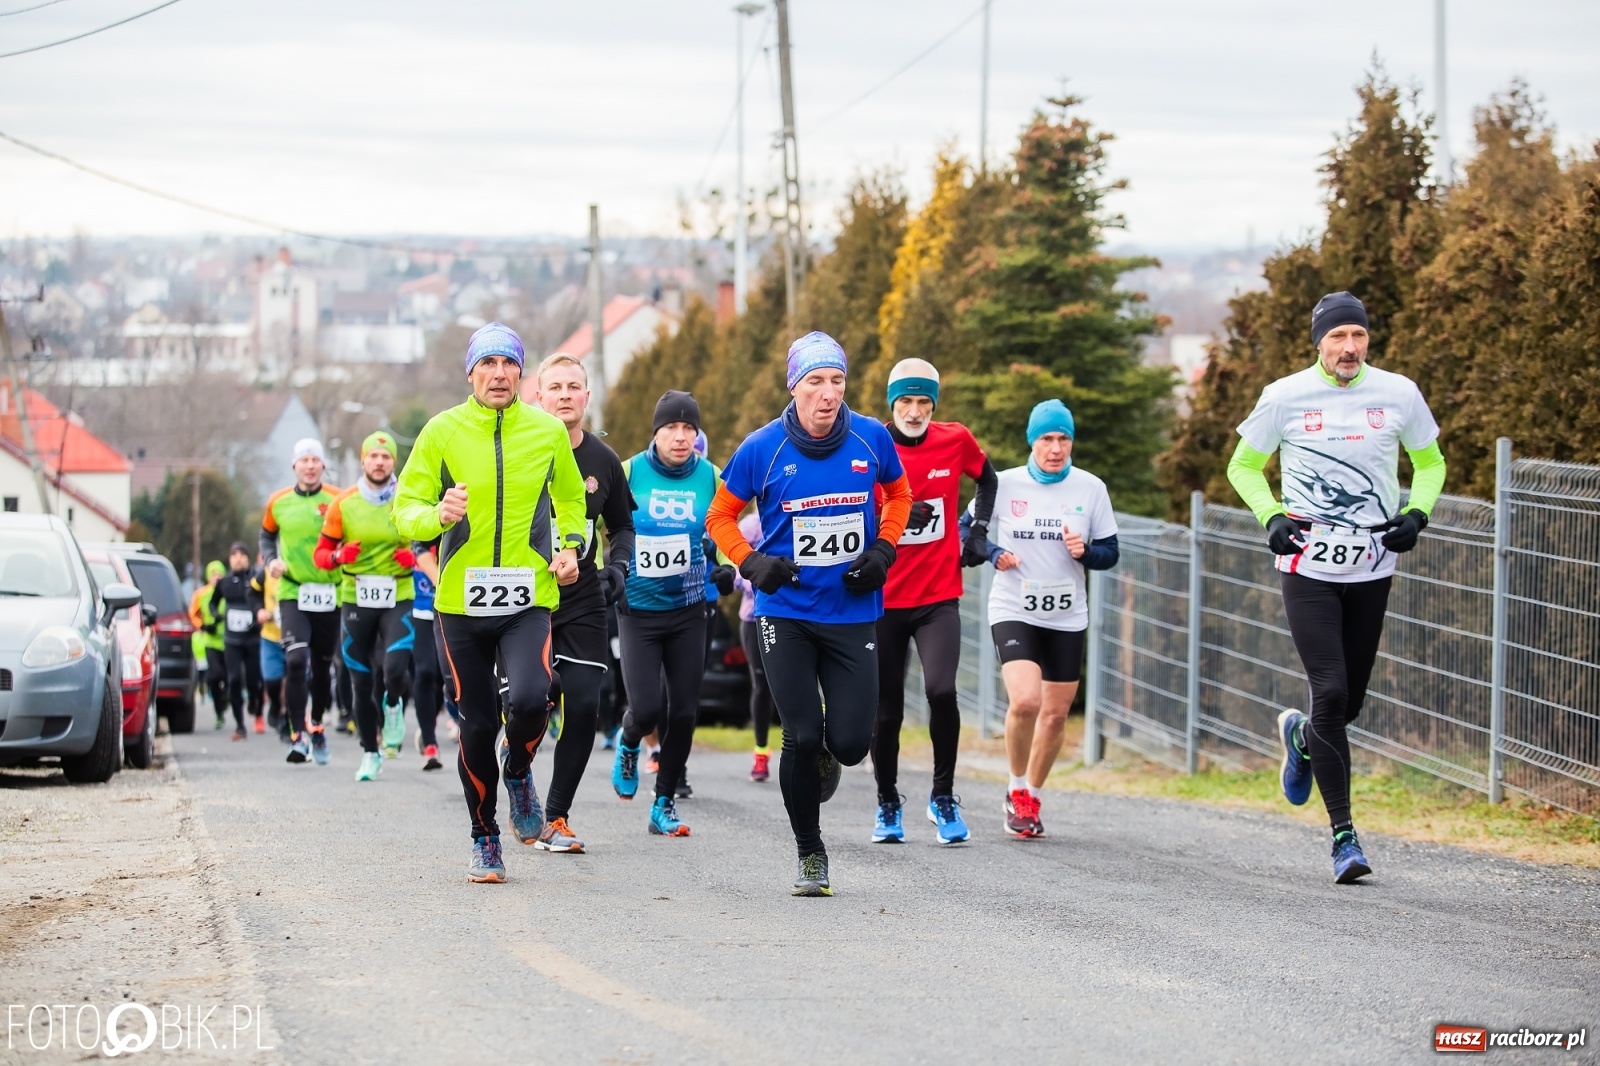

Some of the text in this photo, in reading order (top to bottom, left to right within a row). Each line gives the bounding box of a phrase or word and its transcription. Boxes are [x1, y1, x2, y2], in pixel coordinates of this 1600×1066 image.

[649, 497, 696, 522] bbl
[801, 495, 866, 509] HELUKABEL
[1035, 518, 1062, 527] BIEG
[798, 531, 860, 557] 240
[1013, 531, 1063, 541] BEZ GRA
[640, 549, 687, 569] 304
[1311, 541, 1366, 565] 287
[302, 594, 333, 606] 282
[360, 587, 393, 600] 387
[469, 585, 531, 607] 223
[1023, 593, 1072, 611] 385
